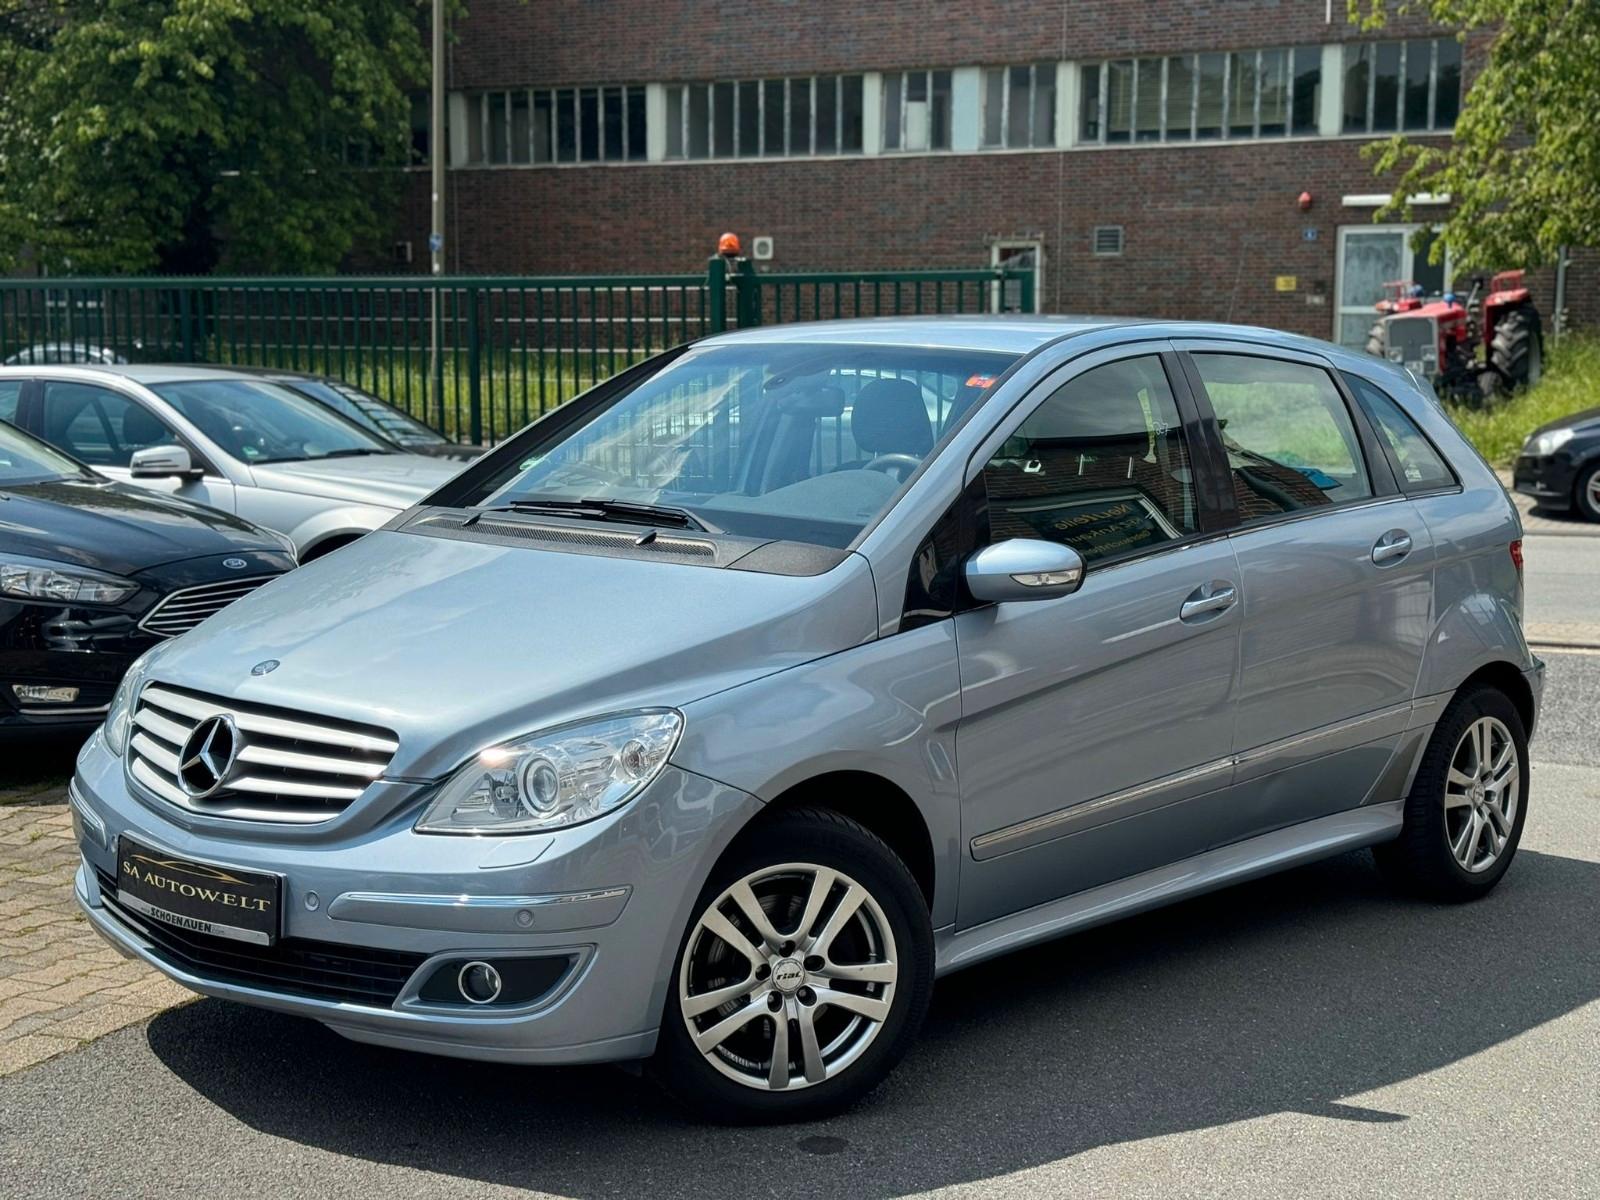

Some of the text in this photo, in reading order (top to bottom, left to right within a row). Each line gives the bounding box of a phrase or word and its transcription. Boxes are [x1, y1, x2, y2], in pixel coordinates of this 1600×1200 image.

[123, 861, 271, 912] SA AUTOWELT
[150, 906, 212, 933] SCHOENAUEN
[776, 971, 801, 980] rial
